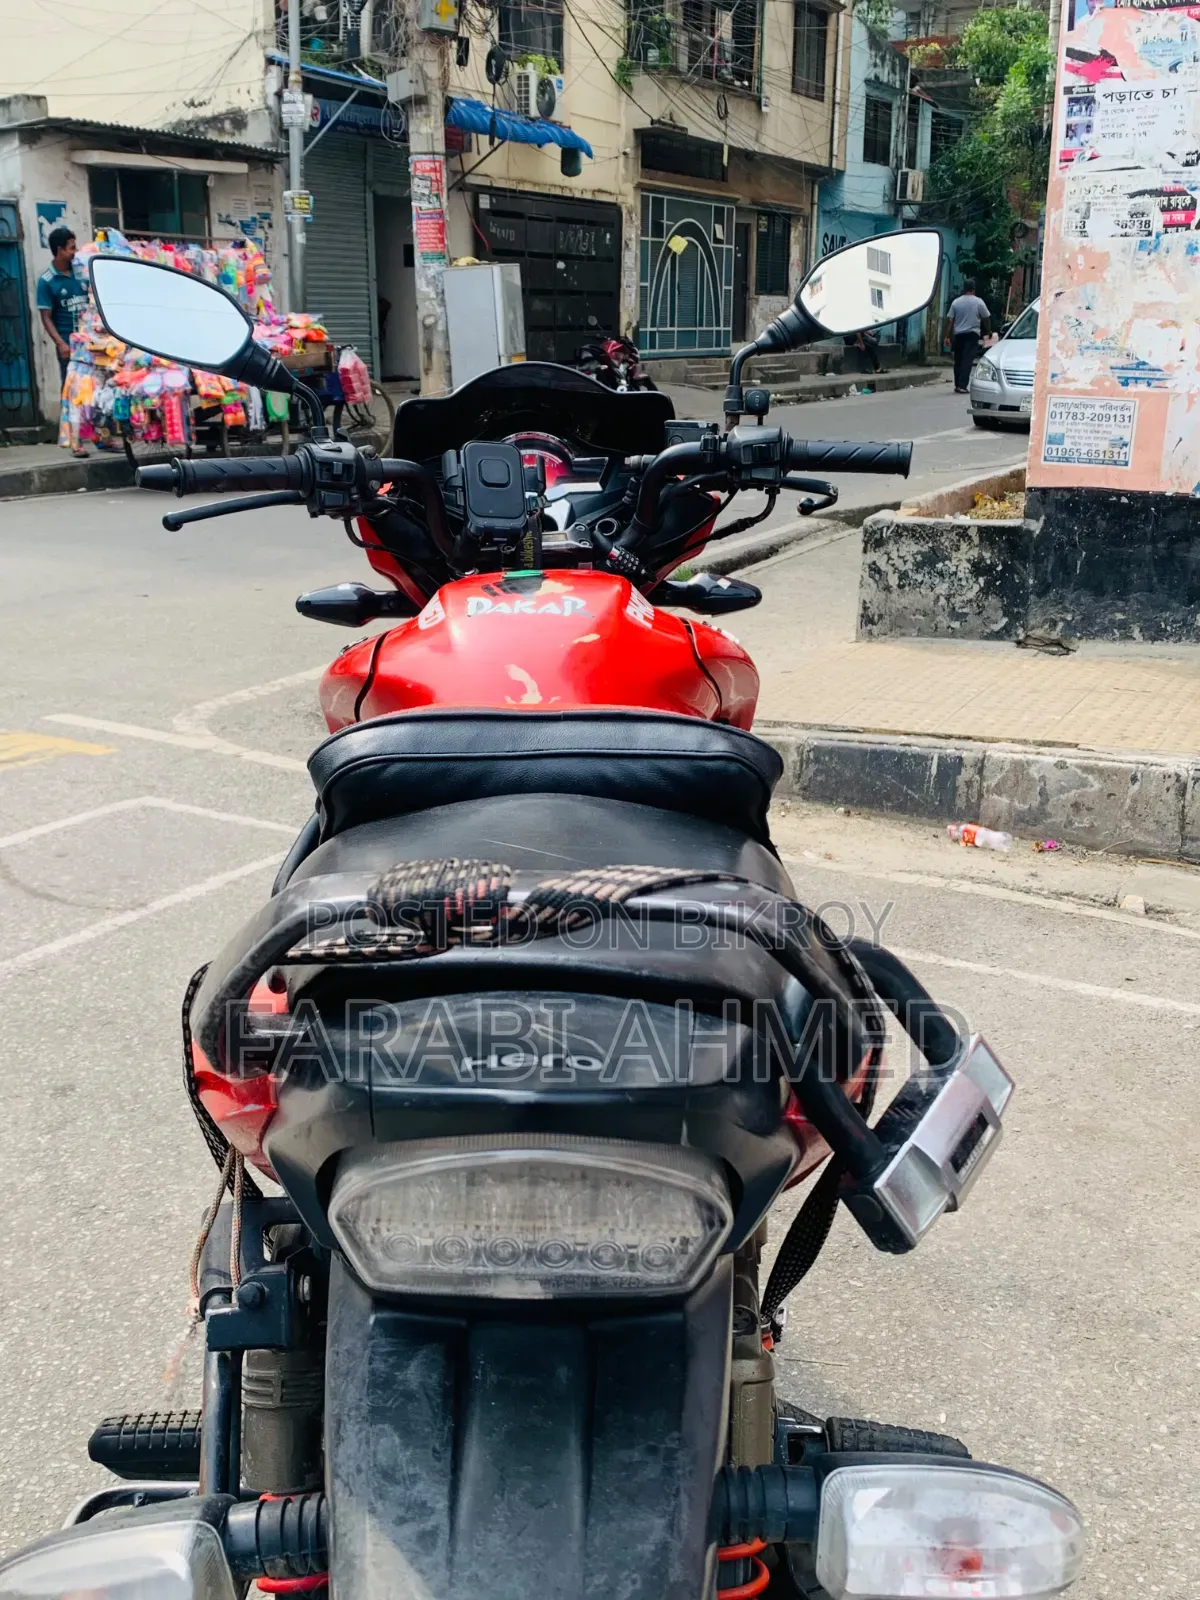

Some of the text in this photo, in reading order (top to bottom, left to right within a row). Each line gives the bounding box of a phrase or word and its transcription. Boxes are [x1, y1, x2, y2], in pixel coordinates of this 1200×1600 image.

[1102, 89, 1155, 104] পড়াতে
[1049, 410, 1132, 424] 01783-209131
[1046, 446, 1128, 460] 01955-651311
[466, 595, 594, 618] DAKAR
[460, 1053, 604, 1072] Hero
